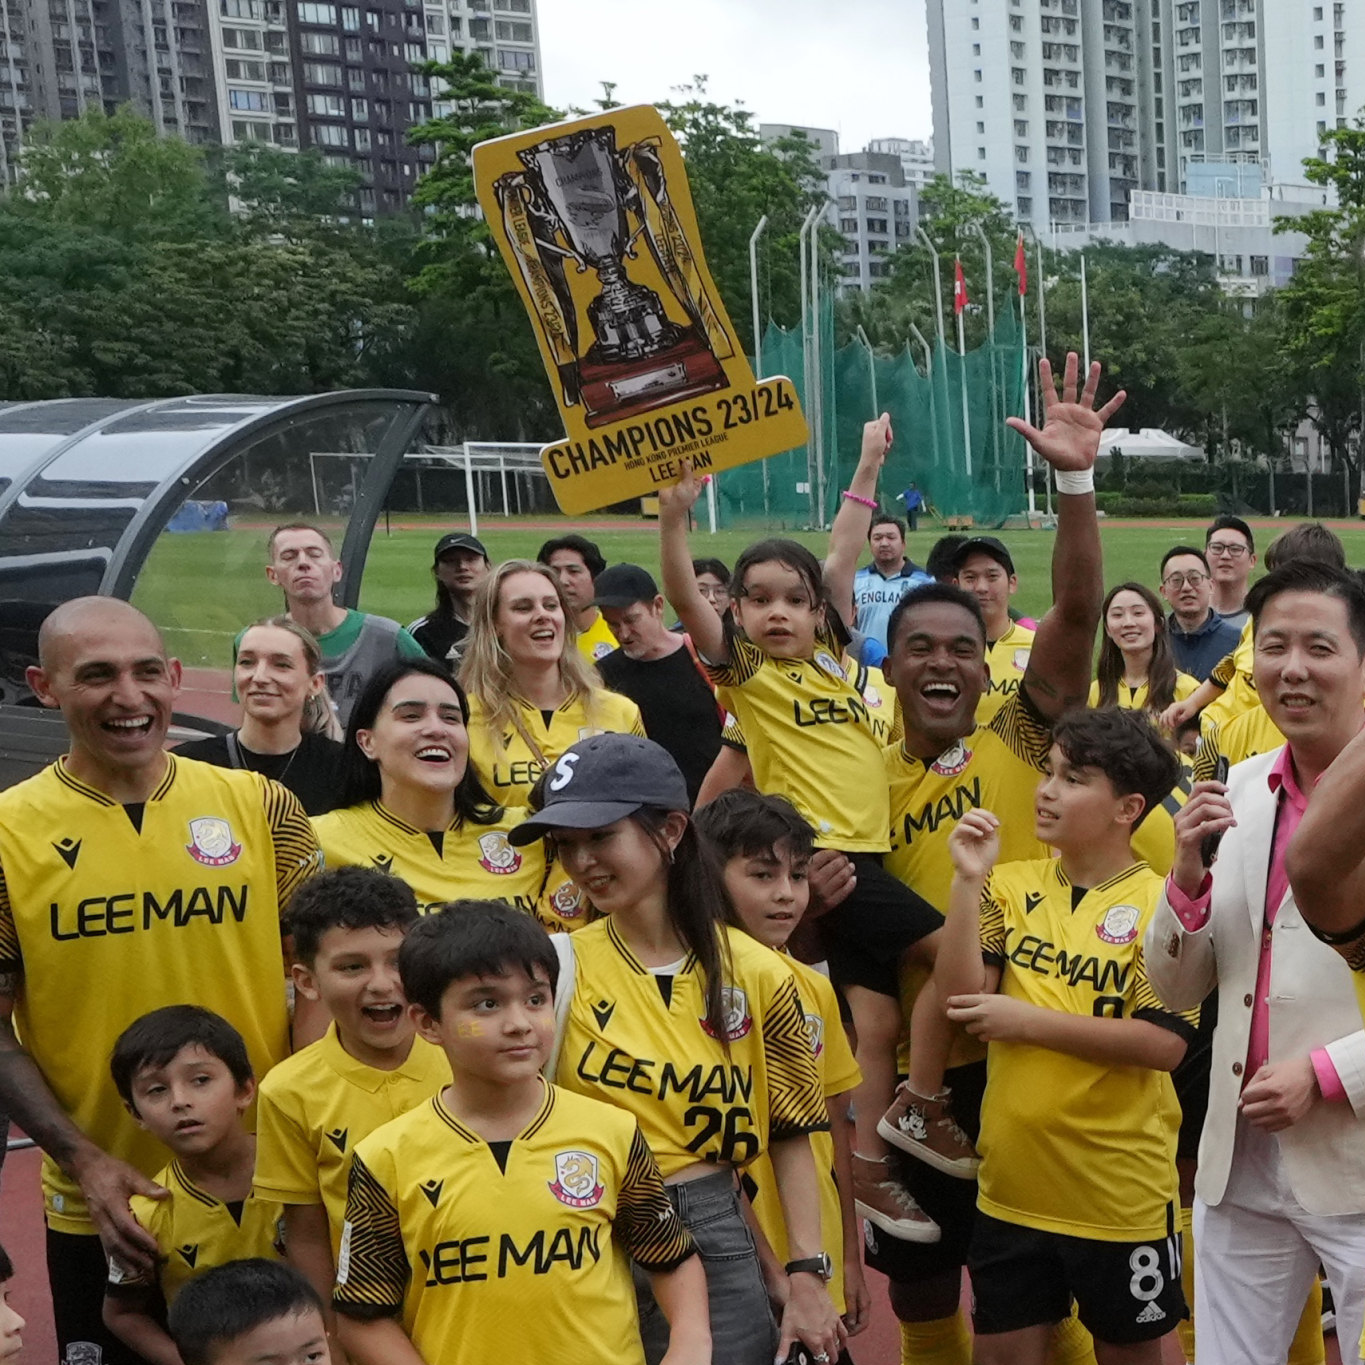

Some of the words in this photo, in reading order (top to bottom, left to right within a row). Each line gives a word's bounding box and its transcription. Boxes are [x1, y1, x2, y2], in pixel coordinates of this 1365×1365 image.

[548, 406, 713, 479] CHAMPIONS
[717, 382, 794, 430] 23/24
[624, 457, 645, 471] HONG
[667, 442, 701, 461] PREMIER
[701, 431, 729, 448] LEAGUE
[649, 463, 677, 483] LEE
[679, 451, 713, 475] AN
[987, 679, 1023, 696] MA
[793, 698, 852, 727] LEE
[550, 752, 580, 793] S
[904, 777, 981, 845] MAN
[197, 855, 216, 865] LEE
[489, 865, 505, 874] LEE
[51, 893, 136, 942] LEE
[142, 884, 248, 931] MAN
[1055, 950, 1129, 993] MAN
[577, 1040, 655, 1096] LEE
[655, 1062, 754, 1104] MAN
[682, 1105, 759, 1165] 26
[559, 1192, 577, 1205] LEE
[579, 1196, 598, 1207] MAN
[497, 1226, 602, 1279] MAN
[1129, 1246, 1165, 1301] 8
